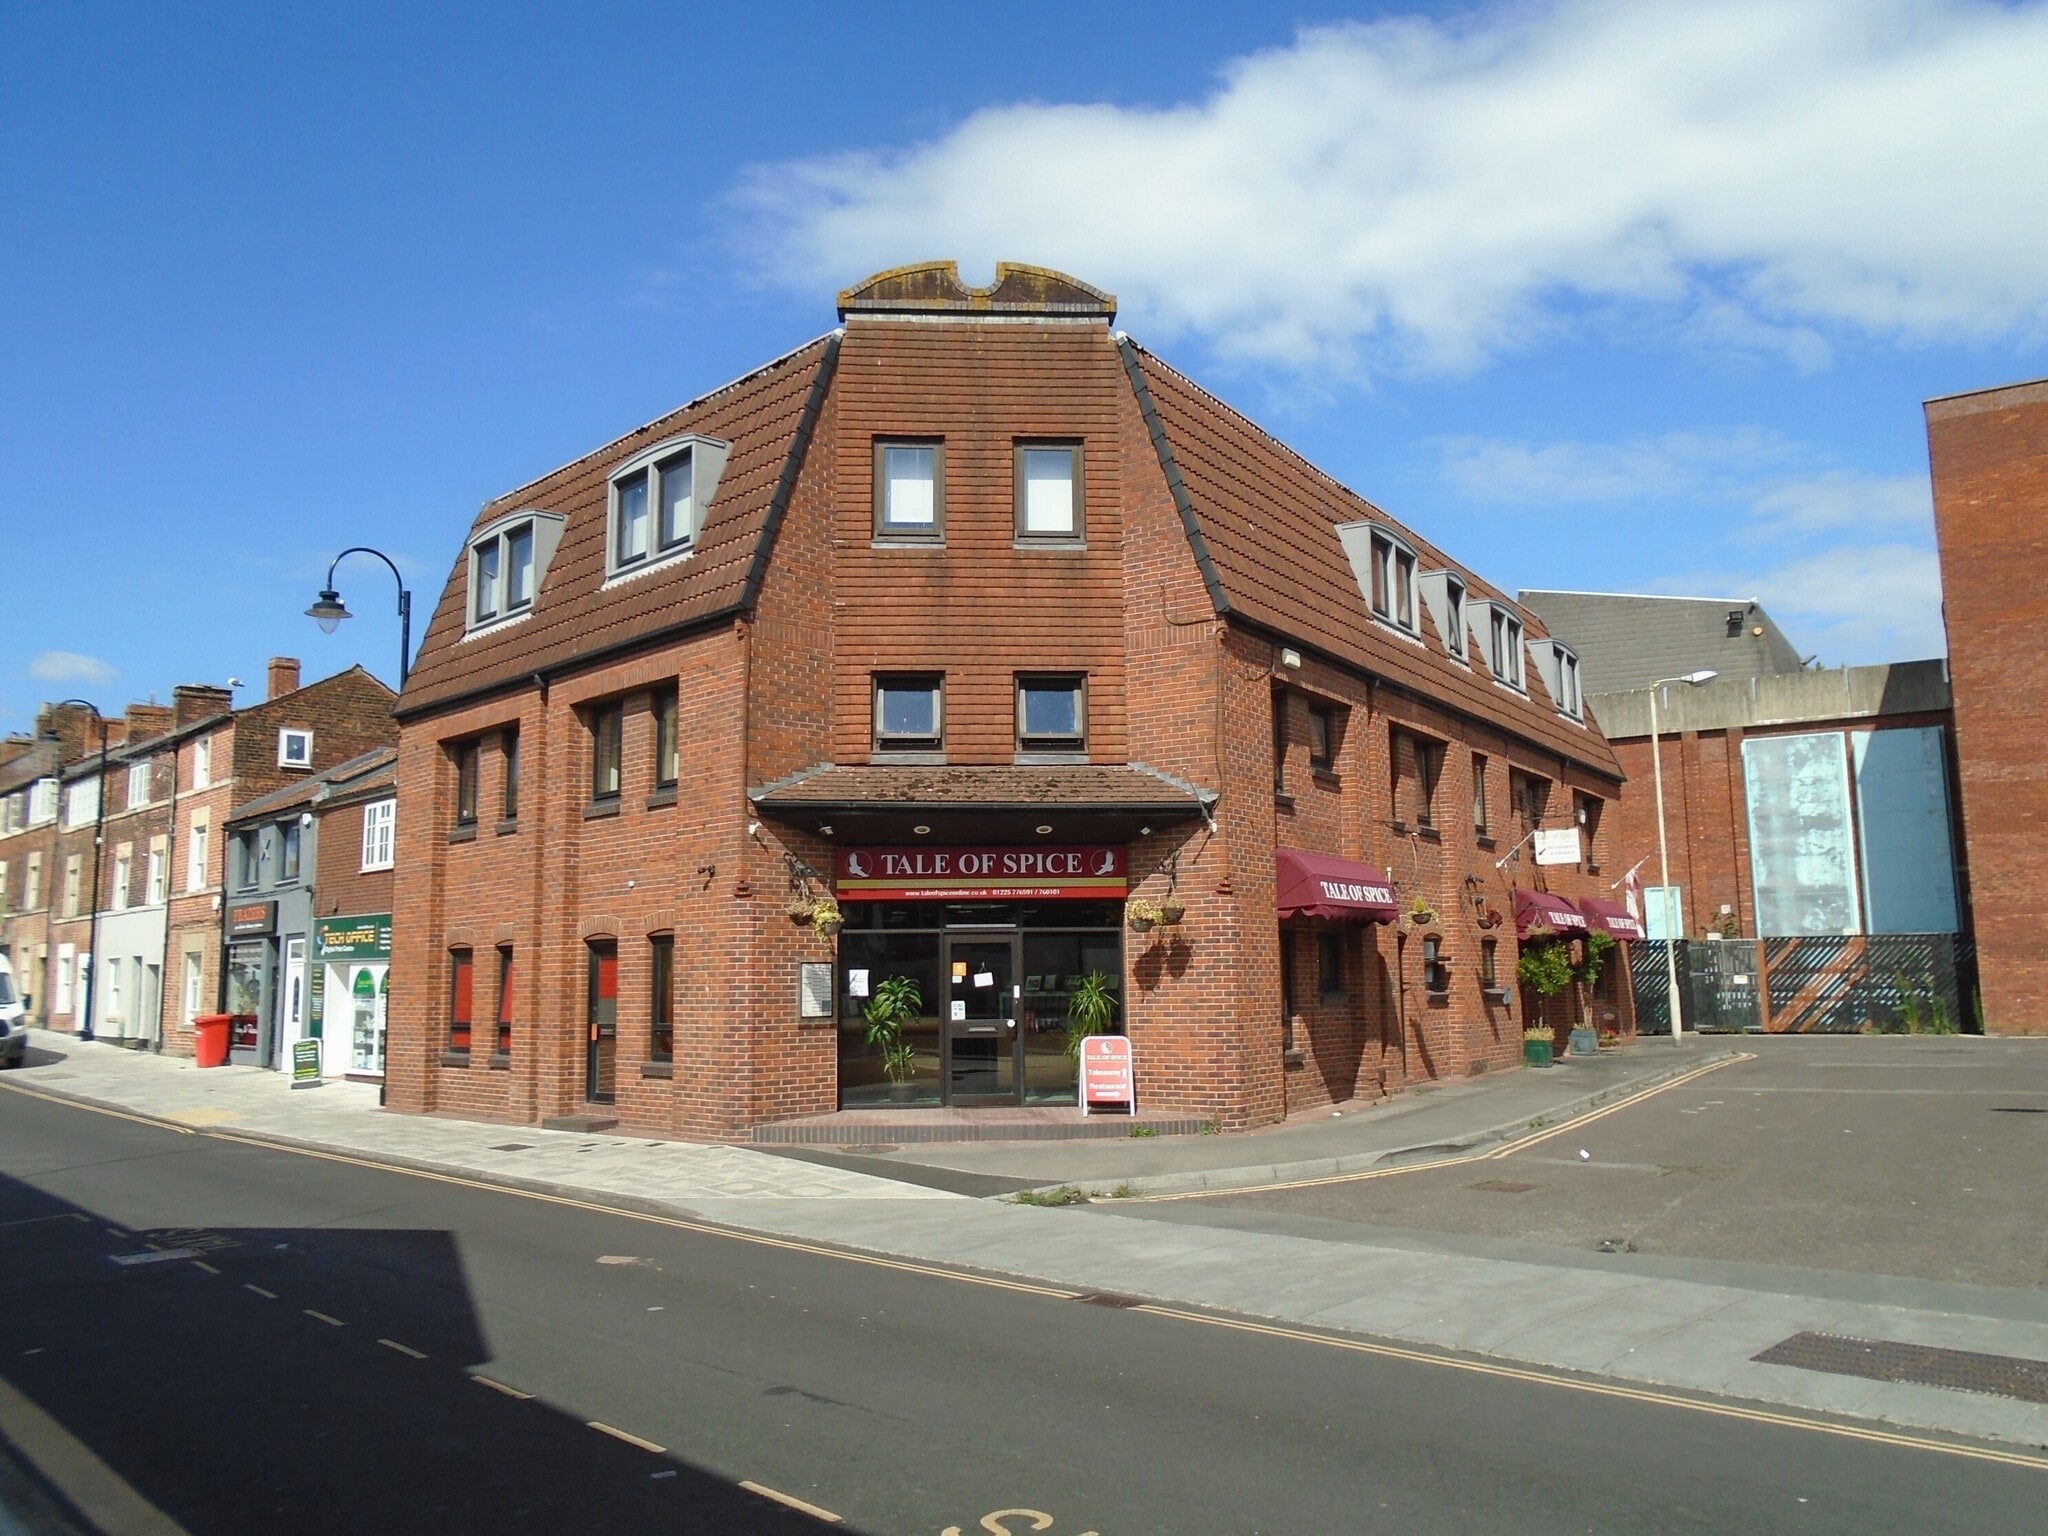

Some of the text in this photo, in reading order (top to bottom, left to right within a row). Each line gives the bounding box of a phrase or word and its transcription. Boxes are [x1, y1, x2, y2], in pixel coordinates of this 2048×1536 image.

[881, 853, 1083, 875] TALE OF SPICE
[1320, 881, 1393, 903] TALE OF SPICE
[324, 932, 345, 945] TECH
[345, 930, 375, 944] OFFICE
[1088, 1069, 1121, 1078] Takeaway
